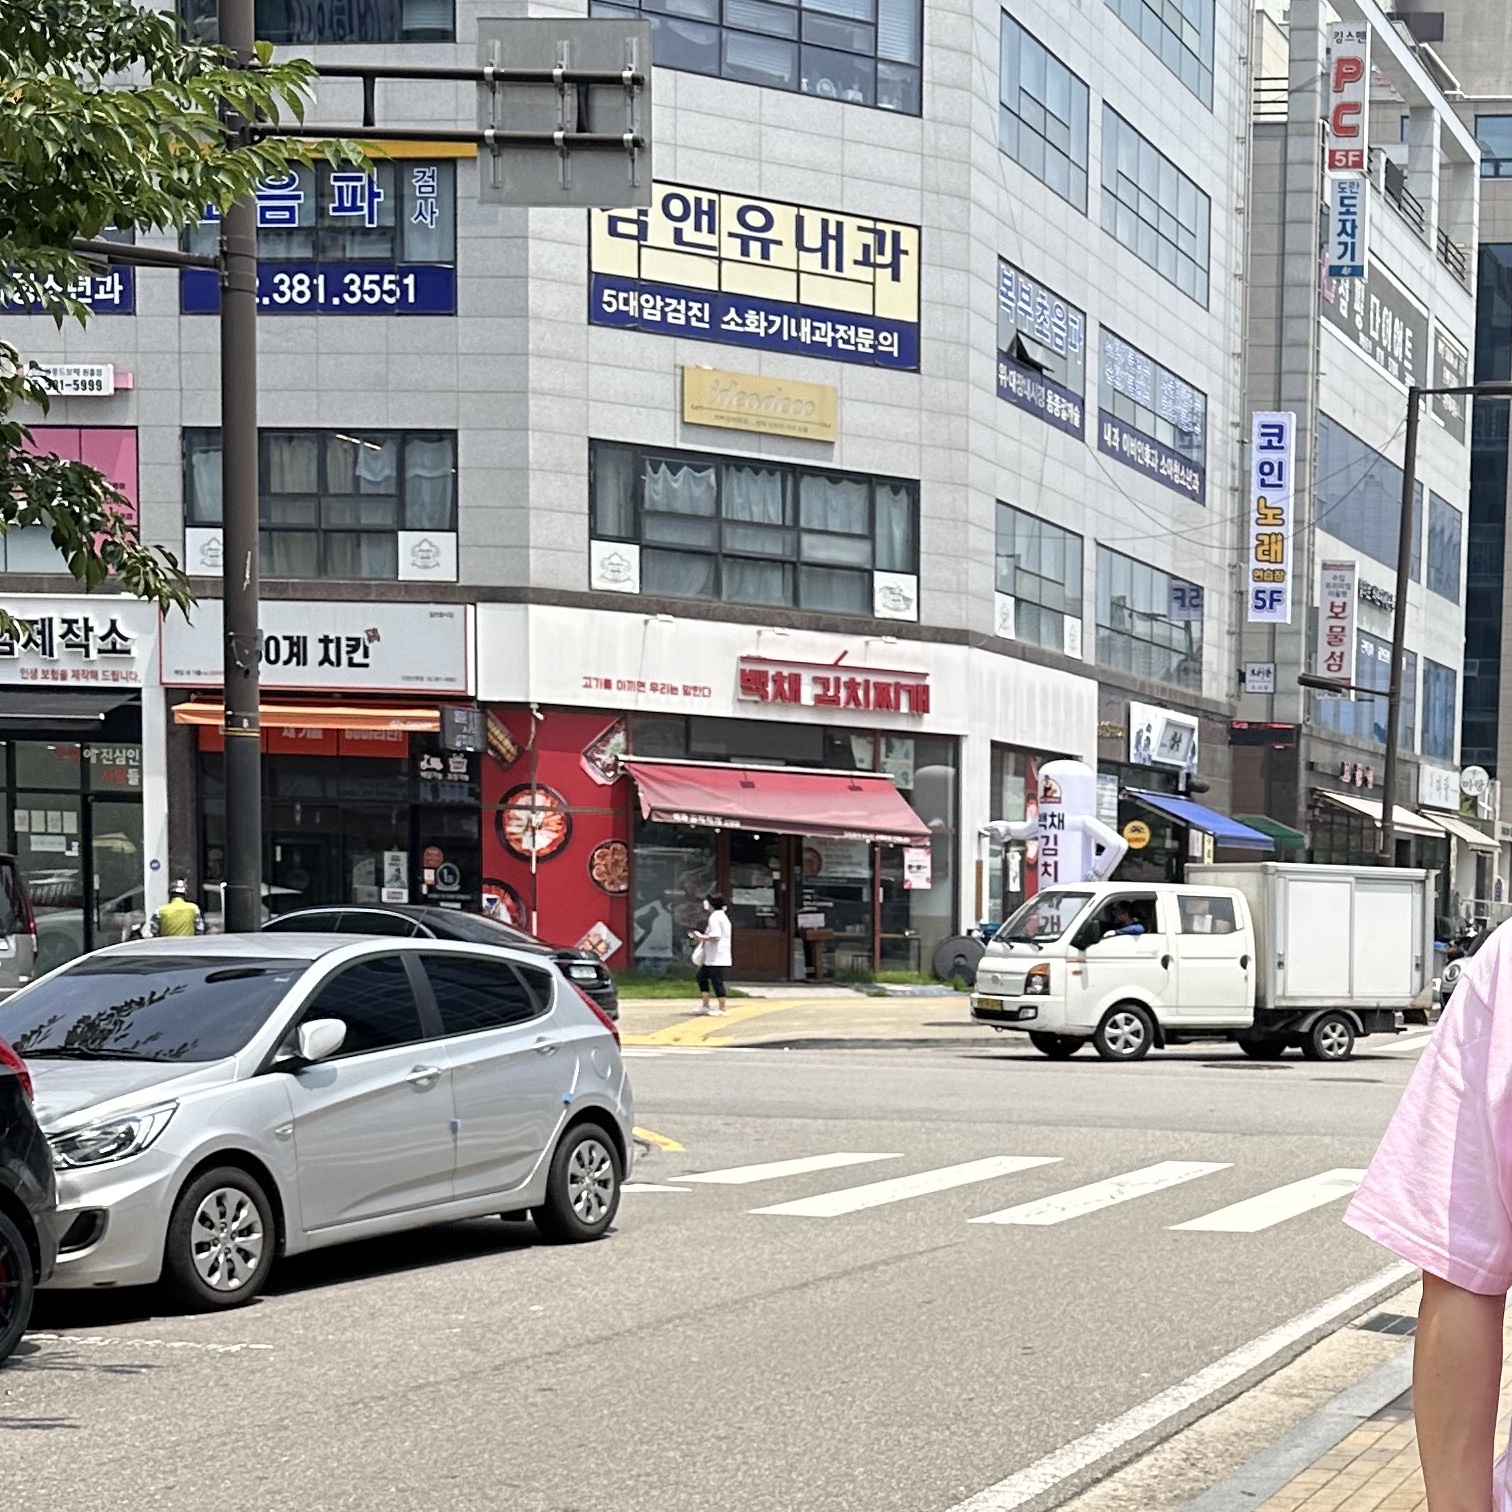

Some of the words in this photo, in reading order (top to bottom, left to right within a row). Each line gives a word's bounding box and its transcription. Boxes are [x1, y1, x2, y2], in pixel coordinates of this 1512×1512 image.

[1332, 57, 1364, 137] PC
[1334, 151, 1362, 167] 5F
[186, 167, 384, 228] 음파
[411, 167, 438, 229] 검사
[1336, 196, 1359, 263] 도자기
[256, 274, 417, 305] .381.3551
[602, 289, 710, 329] 5대암검진
[720, 310, 899, 357] 소화기내과전문의
[998, 264, 1084, 365] 복부초음파
[1103, 422, 1120, 451] 내과
[1254, 590, 1283, 610] 5F
[257, 635, 308, 667] 0계
[318, 635, 370, 668] 치킨
[1323, 601, 1348, 673] 보물섬
[20, 668, 38, 680] 인생
[41, 668, 68, 681] 보험을
[71, 668, 99, 682] 제작해
[582, 676, 613, 690] 고기를
[616, 679, 647, 693] 아끼면
[649, 681, 679, 696] 우리는
[739, 668, 802, 704] 백채
[812, 675, 931, 714] 김치찌개
[1038, 812, 1065, 831] 백채
